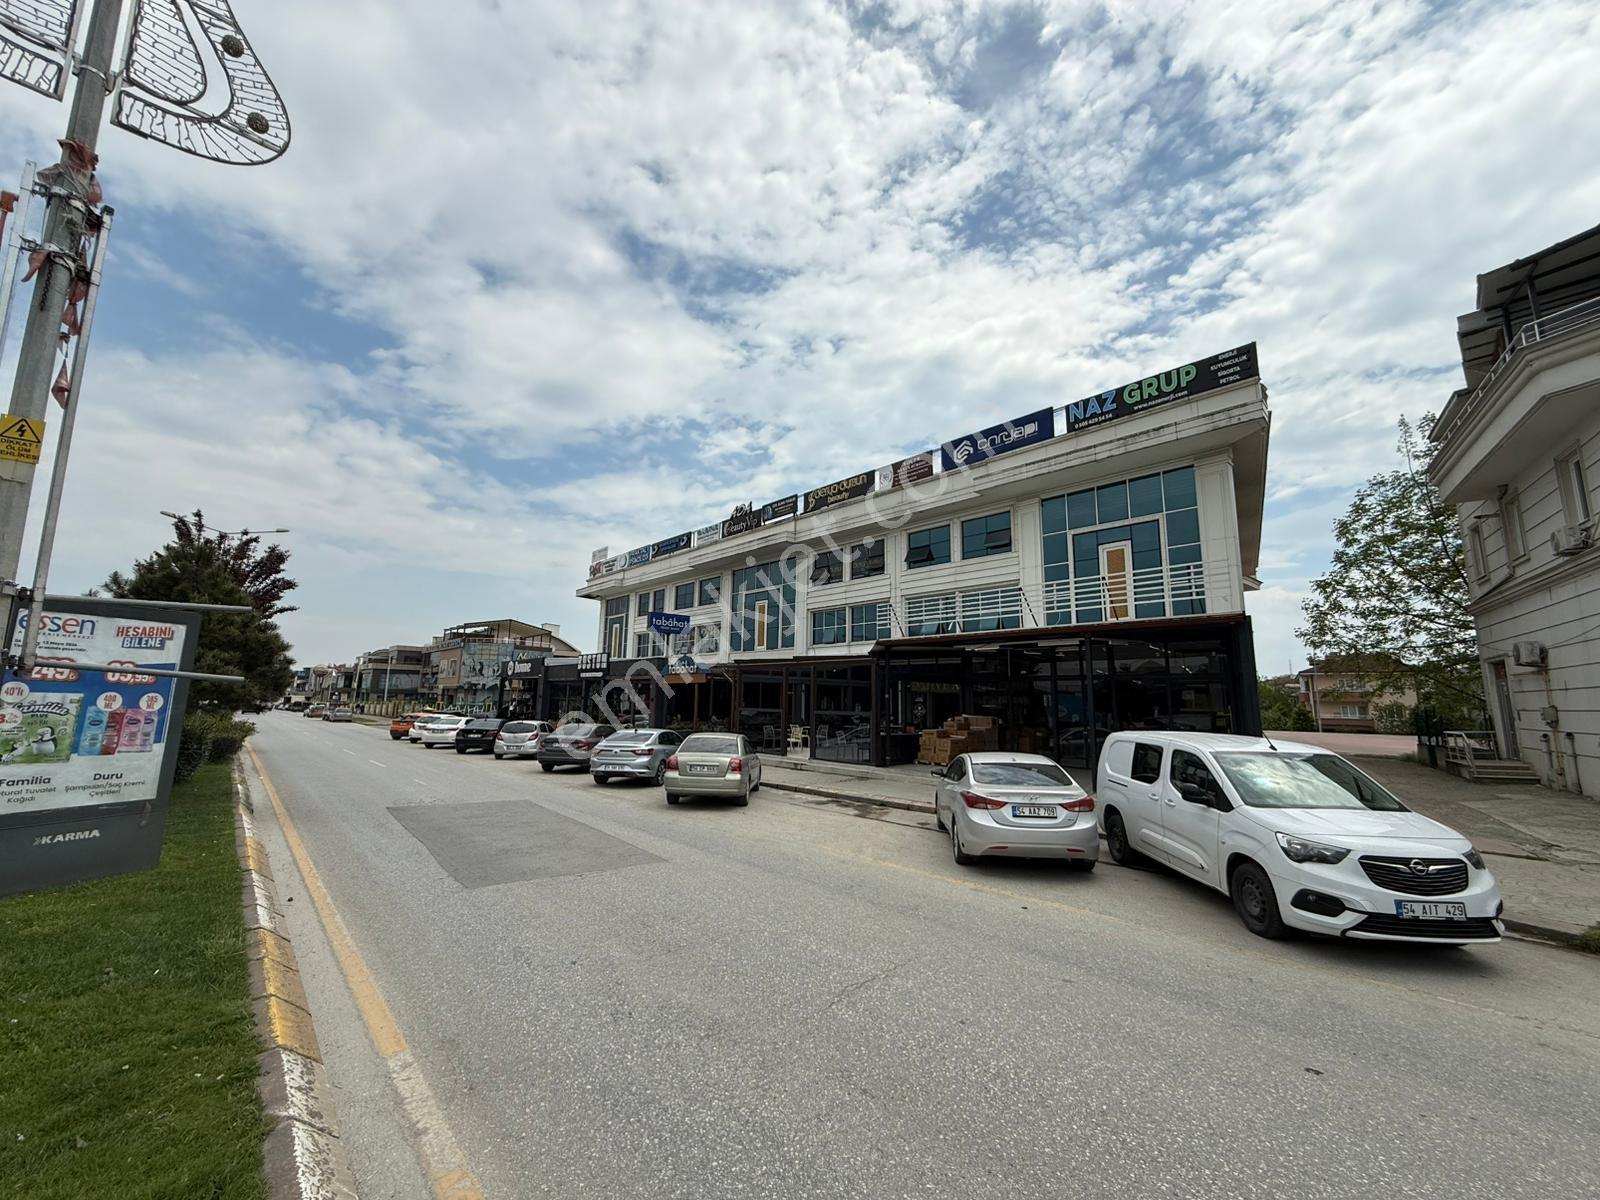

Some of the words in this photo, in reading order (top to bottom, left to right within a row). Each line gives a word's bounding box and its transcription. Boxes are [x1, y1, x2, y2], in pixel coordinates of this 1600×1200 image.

[1069, 391, 1117, 422] NAZ
[1123, 364, 1197, 404] GRUP
[116, 626, 172, 638] HESABINI
[0, 776, 52, 787] Familia
[93, 772, 124, 781] Duru
[1028, 807, 1040, 816] AAZ
[1043, 807, 1055, 816] 709
[41, 829, 101, 844] KARMA
[1403, 903, 1415, 914] 54
[1422, 904, 1439, 915] AIT
[1445, 905, 1464, 916] 429
